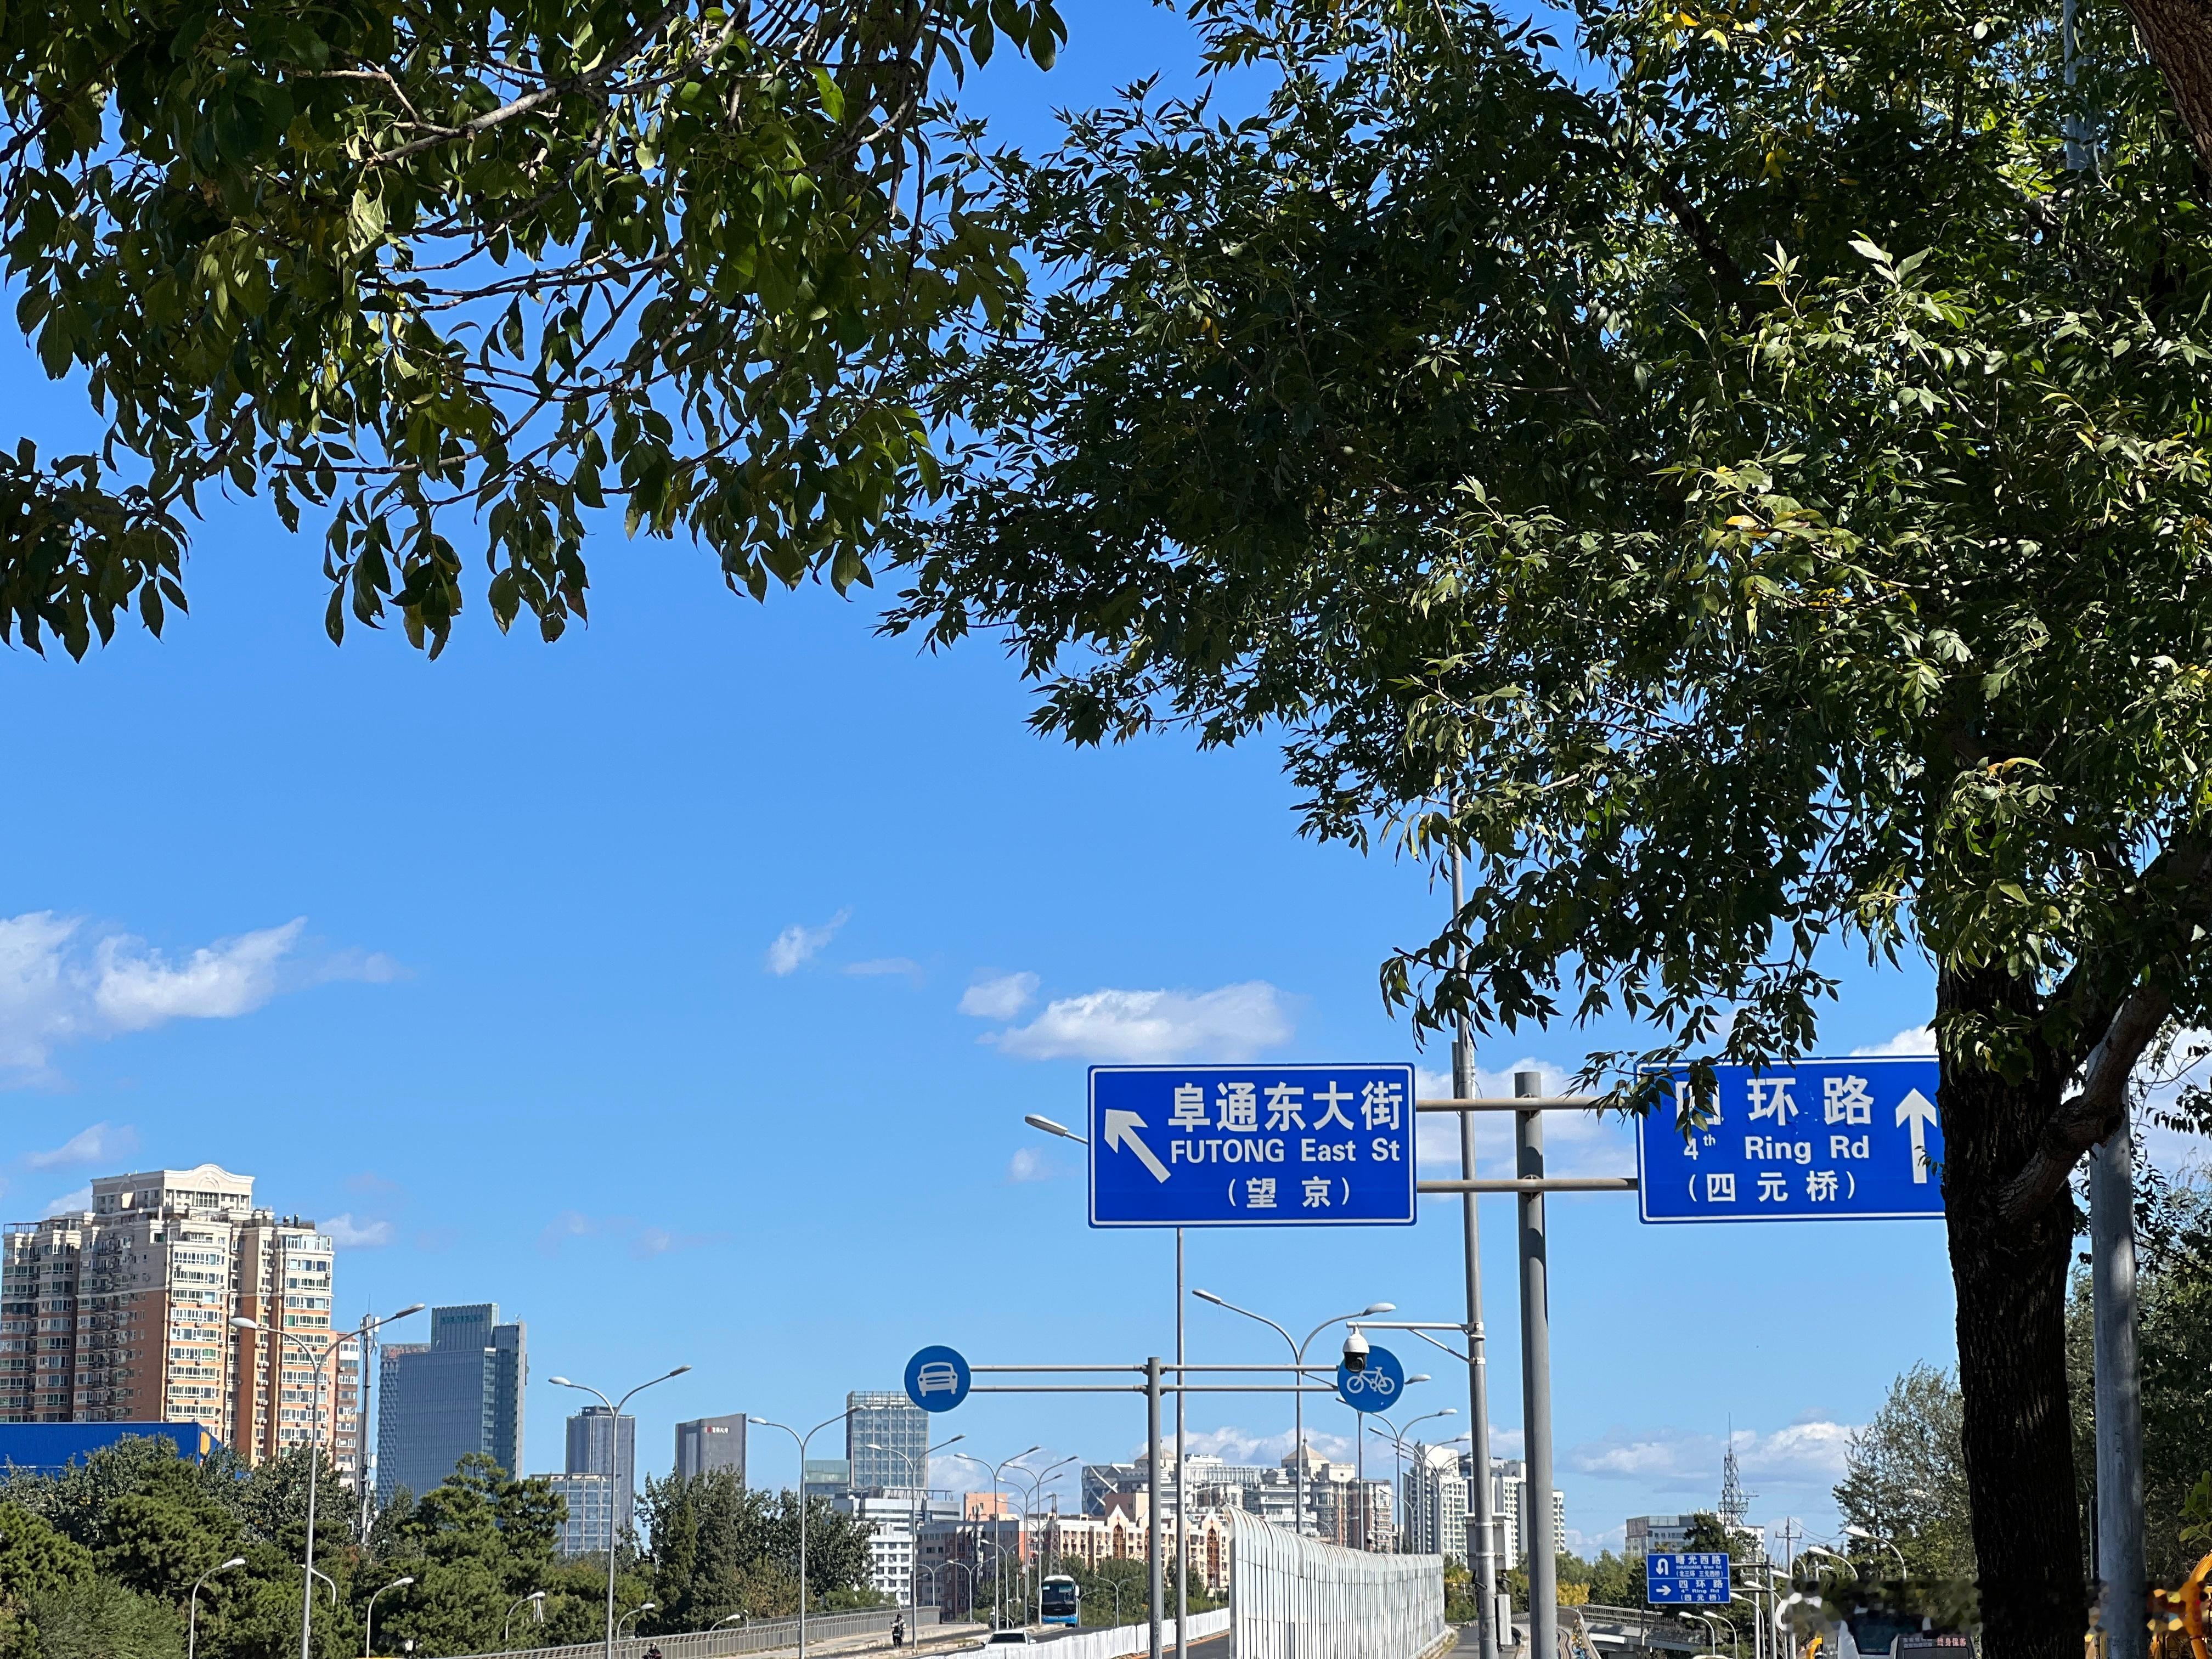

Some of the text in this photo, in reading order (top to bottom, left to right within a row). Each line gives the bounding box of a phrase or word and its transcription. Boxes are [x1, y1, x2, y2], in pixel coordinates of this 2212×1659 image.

[1168, 1081, 1403, 1132] 阜通东大街
[1171, 1137, 1401, 1164] FUTONG East St
[1683, 1134, 1870, 1164] 4th Ring Rd
[1678, 1579, 1723, 1589] 四环路
